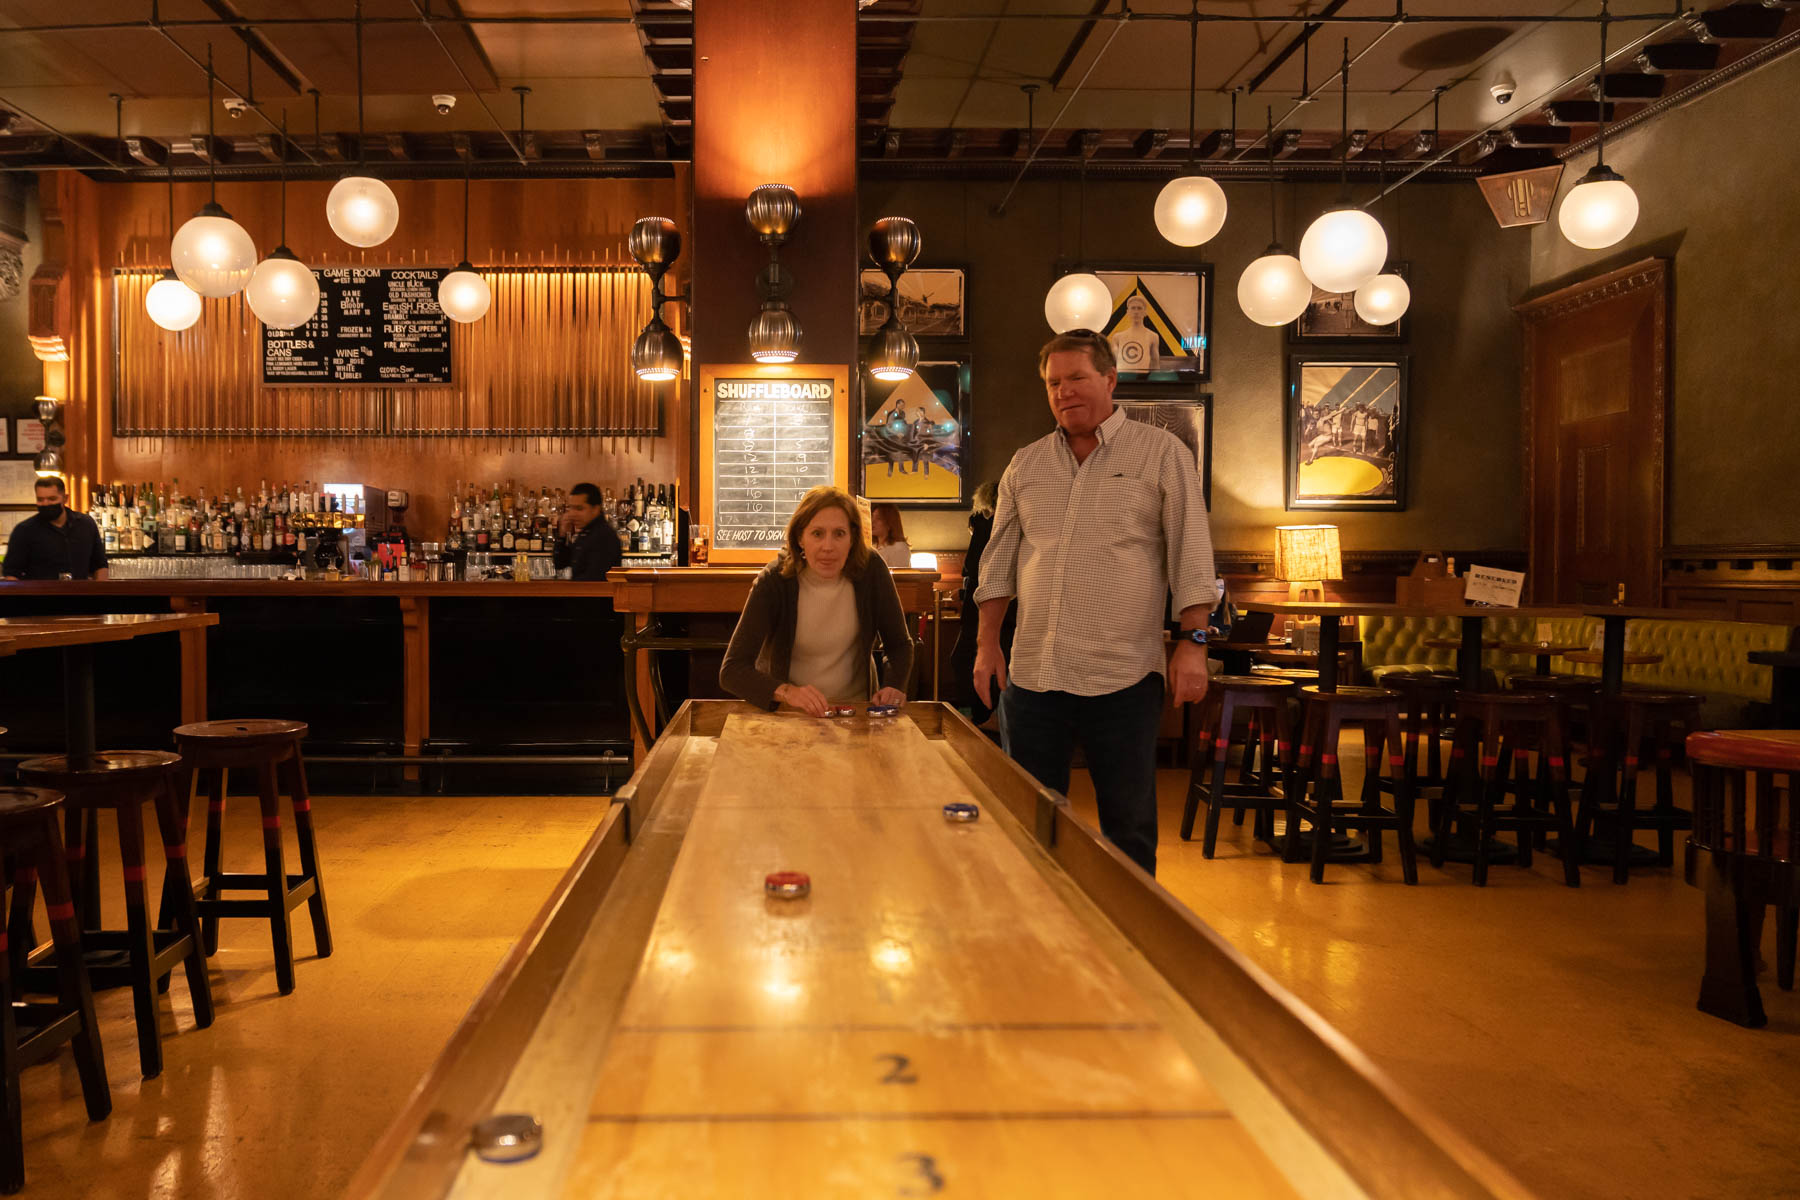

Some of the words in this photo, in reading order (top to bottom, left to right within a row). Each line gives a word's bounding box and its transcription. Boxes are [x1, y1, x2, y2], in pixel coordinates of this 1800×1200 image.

[323, 269, 350, 277] GAME
[353, 268, 380, 277] ROOM
[391, 271, 438, 280] COCKTAILS
[383, 325, 406, 334] RUBY
[267, 340, 307, 349] BOTTLES
[307, 340, 315, 349] &
[266, 348, 292, 357] CANS
[335, 349, 360, 358] WINE
[335, 364, 355, 372] WHITE
[717, 383, 832, 399] SHUFFLEBOARD
[745, 466, 759, 474] 12
[796, 465, 808, 473] 10
[717, 530, 733, 541] SEE
[732, 530, 754, 542] HOST
[754, 530, 766, 541] TO
[766, 530, 786, 541] SIGN
[873, 1052, 919, 1085] 2
[896, 1151, 945, 1198] 3
